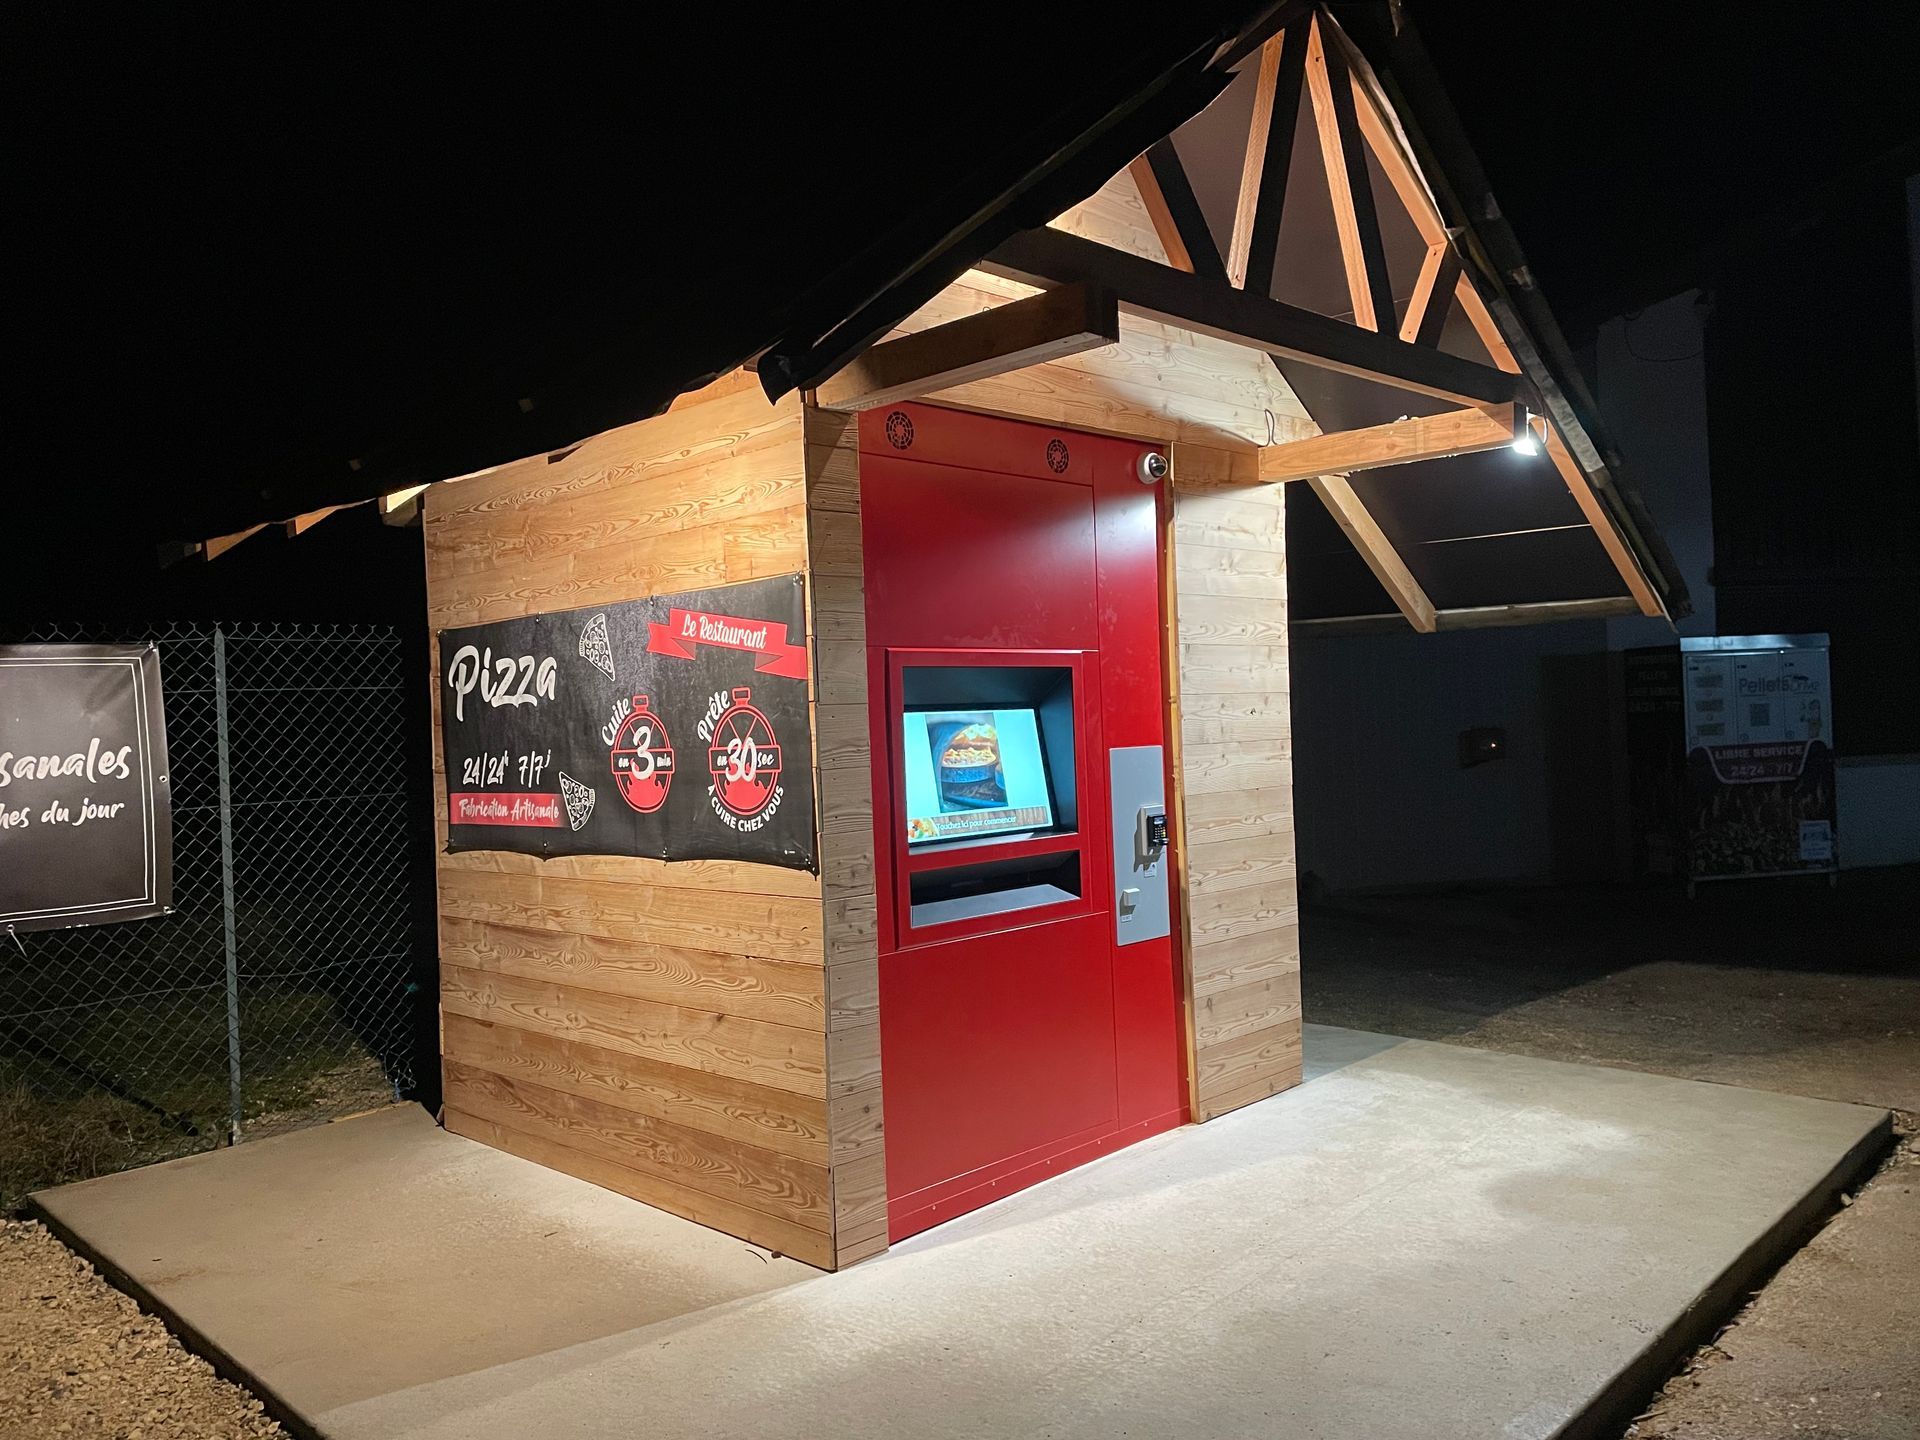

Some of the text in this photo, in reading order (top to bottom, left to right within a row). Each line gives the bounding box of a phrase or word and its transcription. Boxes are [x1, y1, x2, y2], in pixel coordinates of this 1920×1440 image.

[681, 613, 768, 649] Le Restaurant
[448, 645, 557, 722] Pizza
[1738, 677, 1789, 693] Pellets
[601, 698, 631, 747] Cuite
[697, 690, 730, 743] Prête
[0, 737, 132, 788] sanales
[518, 748, 551, 788] 7/7j
[631, 725, 655, 780] 3
[725, 736, 757, 782] 30
[757, 750, 775, 768] sec
[1753, 745, 1803, 758] SERVICE
[41, 800, 69, 824] du
[71, 797, 125, 826] jour
[459, 797, 559, 822] Fabrication Artisanale
[711, 796, 737, 829] CUIRE
[737, 817, 764, 832] CHEZ
[761, 785, 784, 822] VOUS
[969, 820, 983, 829] pour
[984, 816, 1017, 825] commencer
